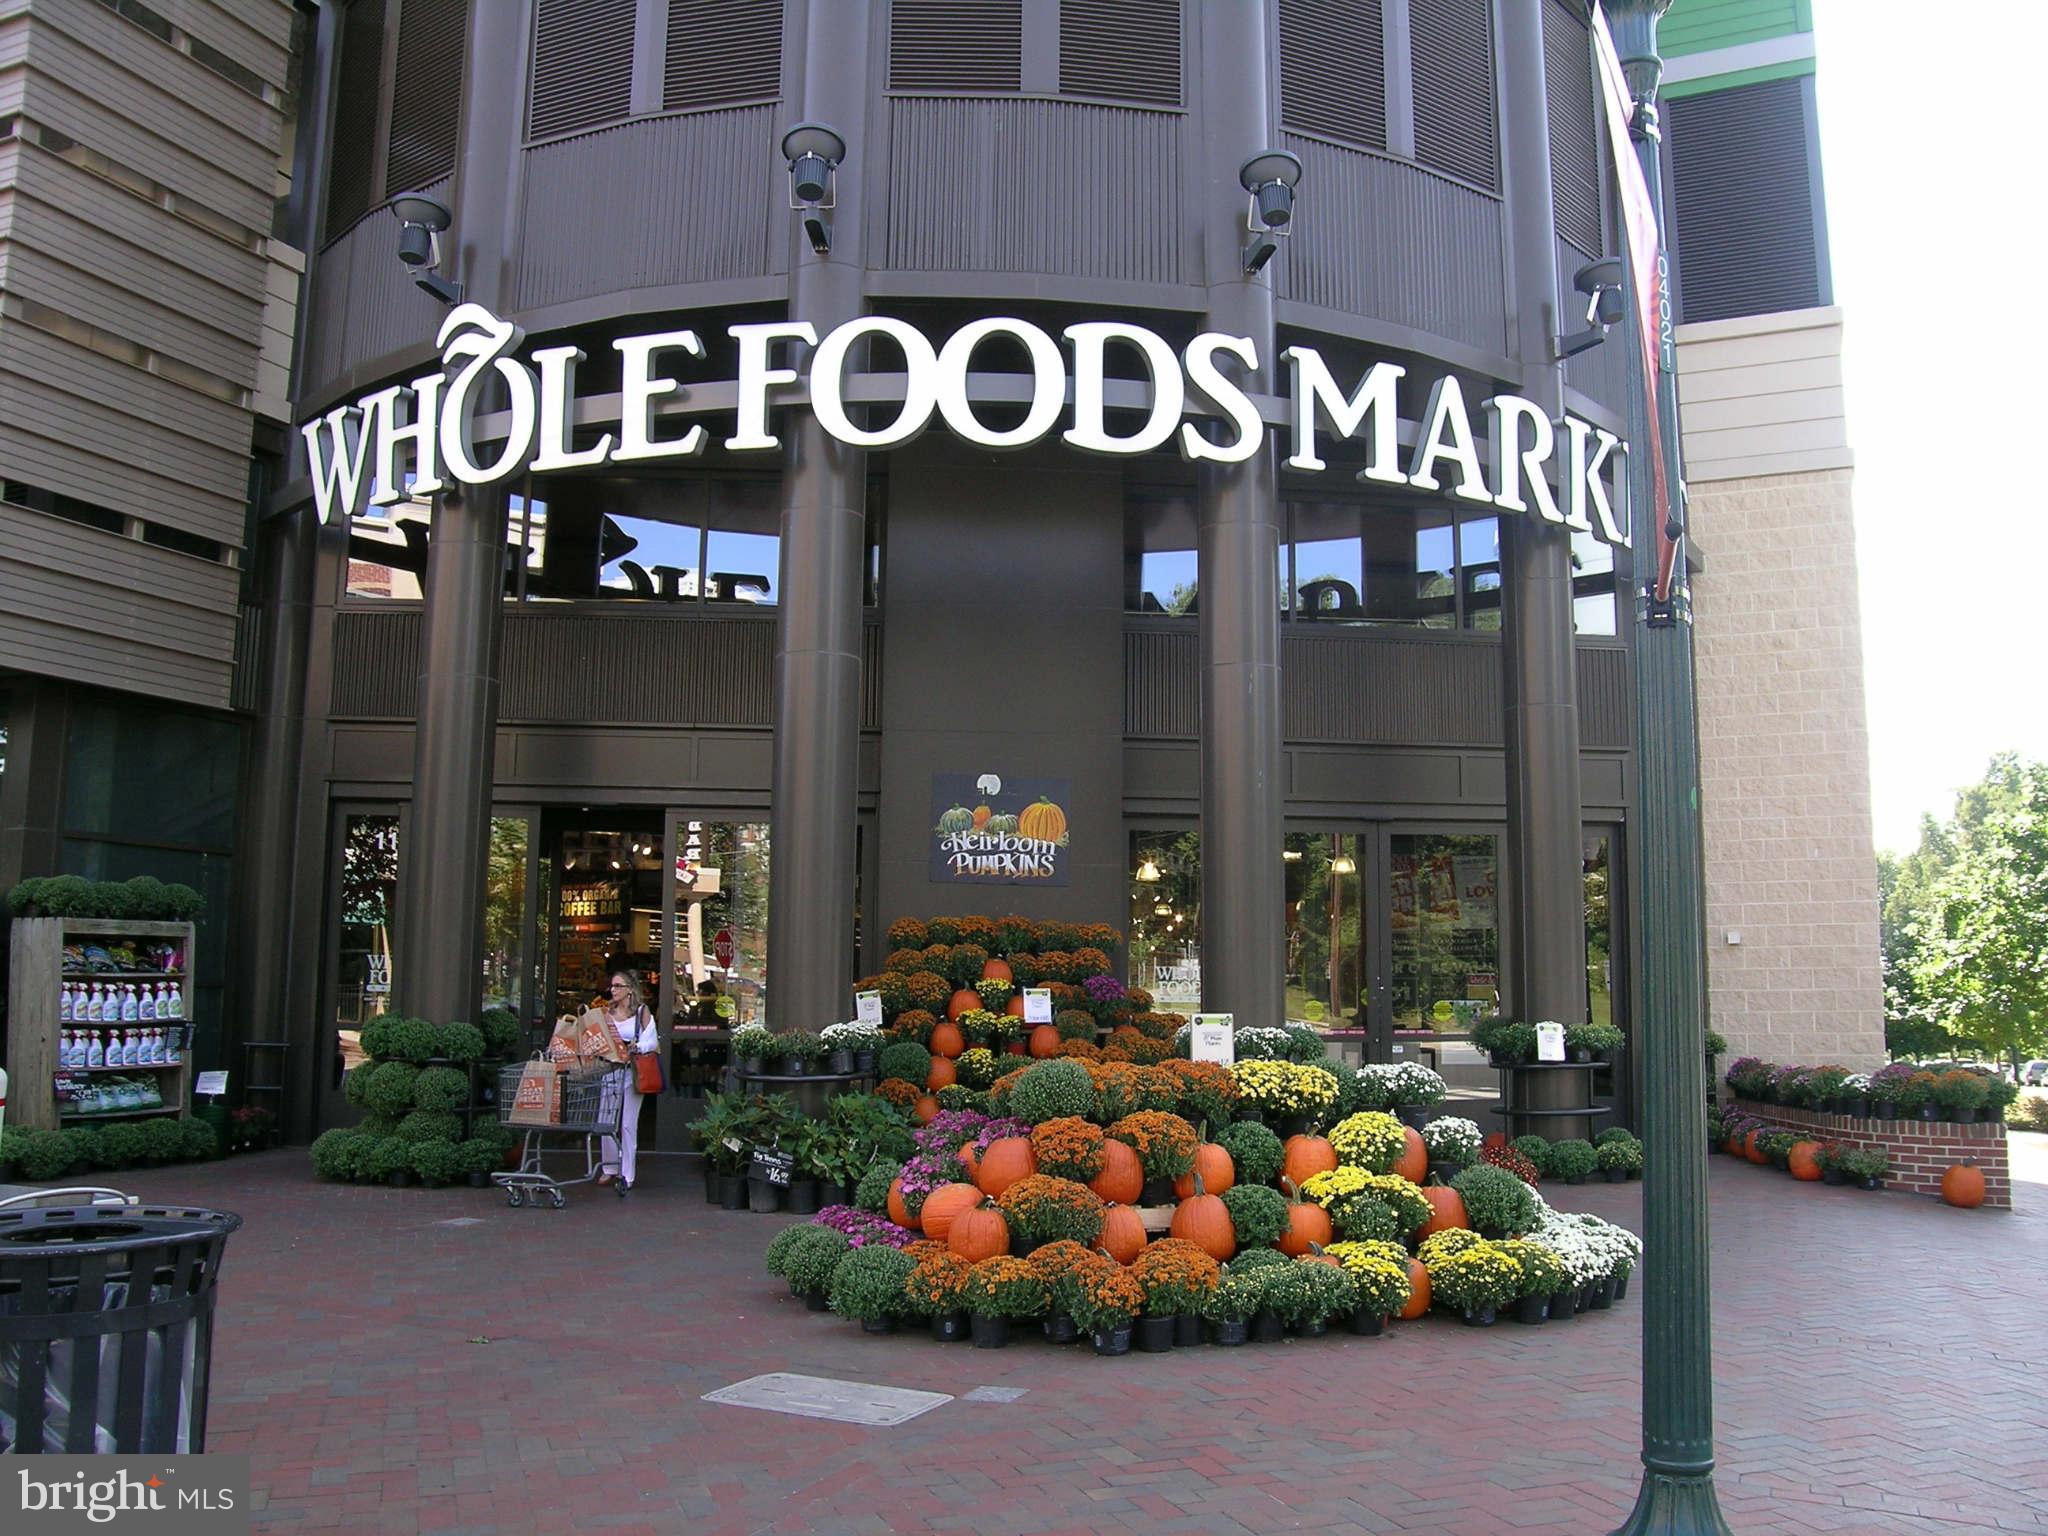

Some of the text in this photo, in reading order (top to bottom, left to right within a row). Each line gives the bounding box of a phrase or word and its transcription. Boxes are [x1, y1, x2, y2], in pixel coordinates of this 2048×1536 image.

[301, 302, 1634, 549] WHOLE FOODS MARK
[941, 831, 1057, 855] Heirloom
[947, 852, 1055, 878] PUMPKINS
